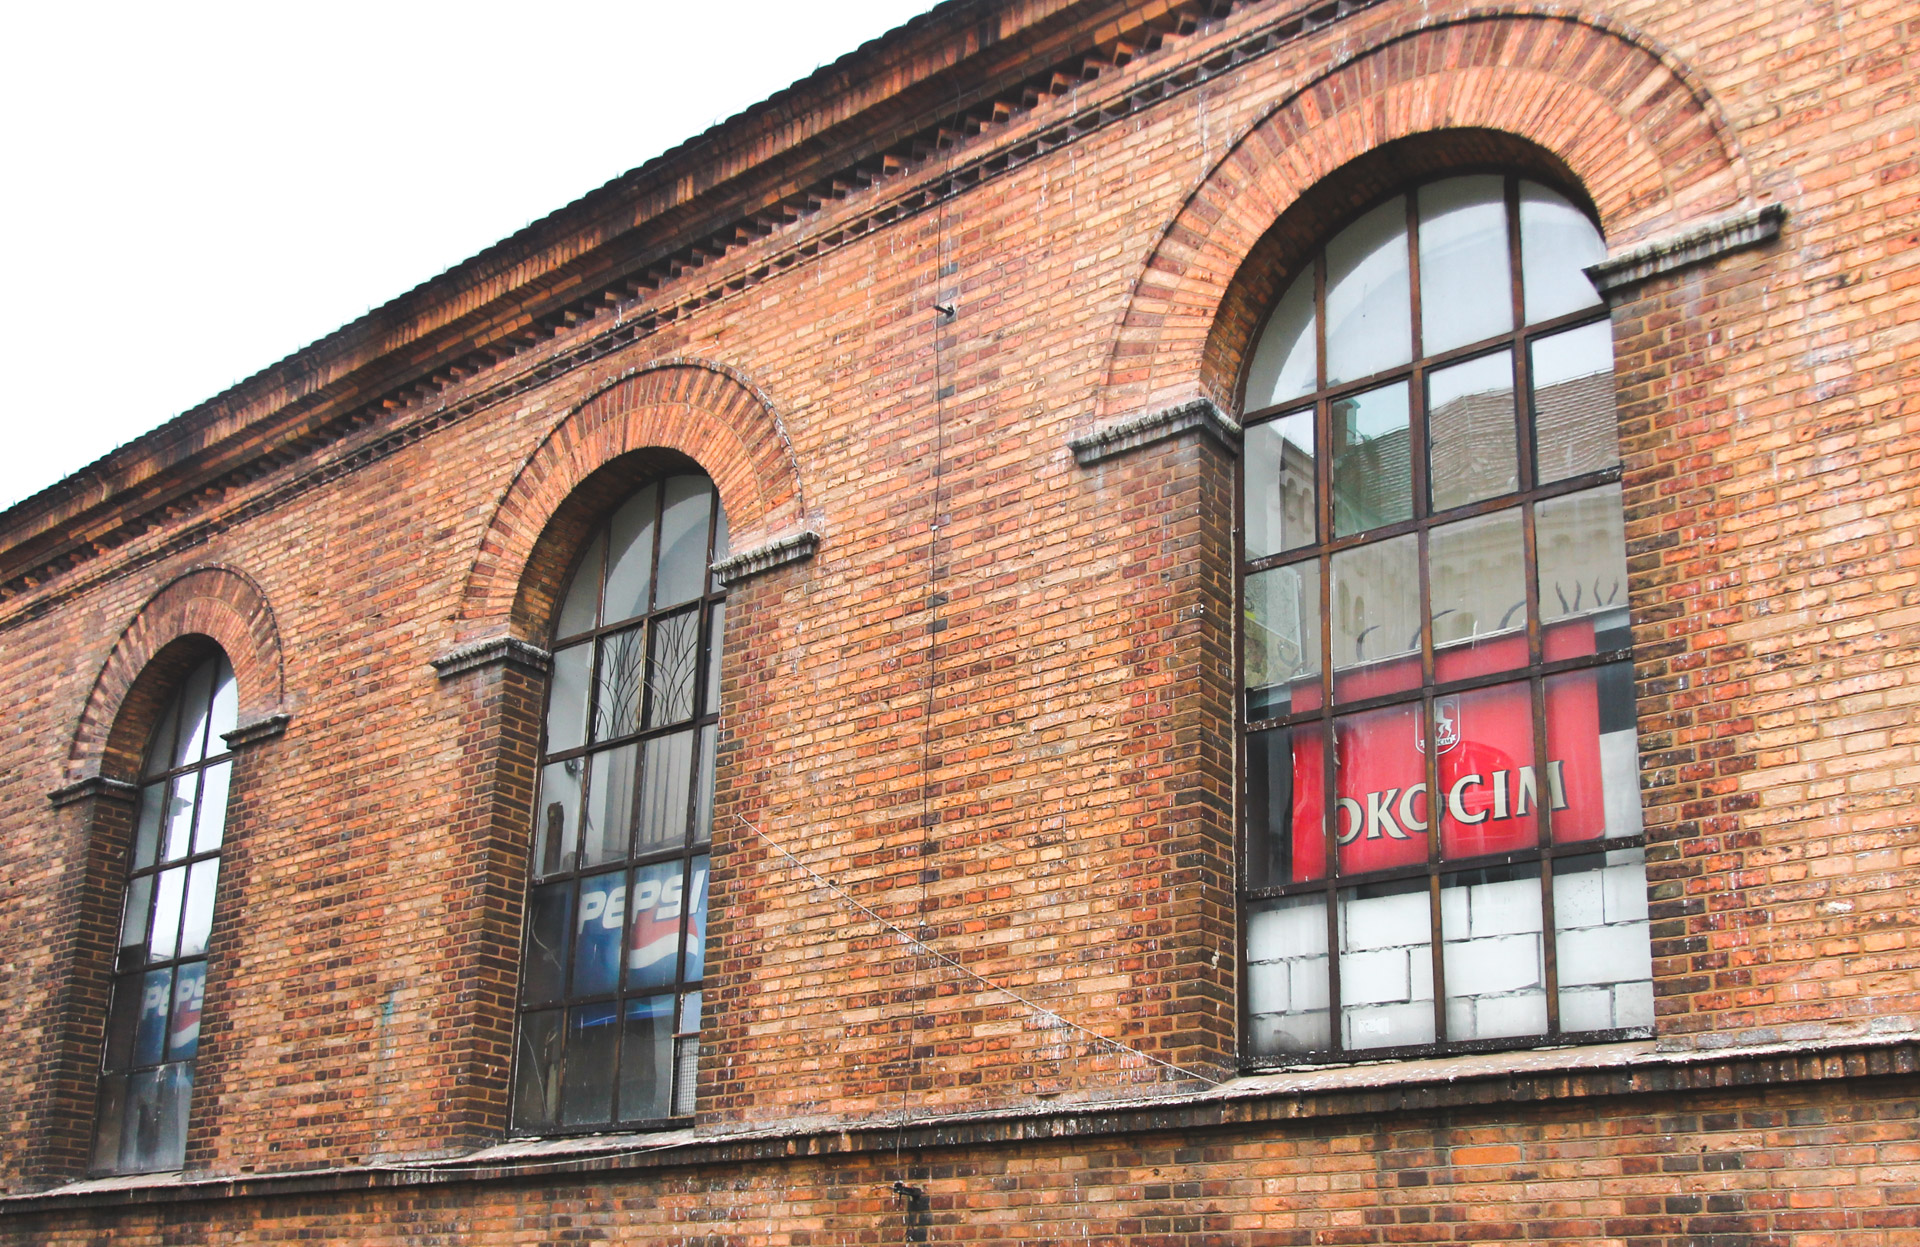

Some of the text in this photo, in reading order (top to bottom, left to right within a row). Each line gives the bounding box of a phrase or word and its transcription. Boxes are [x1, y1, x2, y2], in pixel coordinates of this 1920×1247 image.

[1323, 760, 1569, 847] OKOCIM
[577, 869, 706, 935] PEPSI
[142, 975, 206, 1020] PEPS
